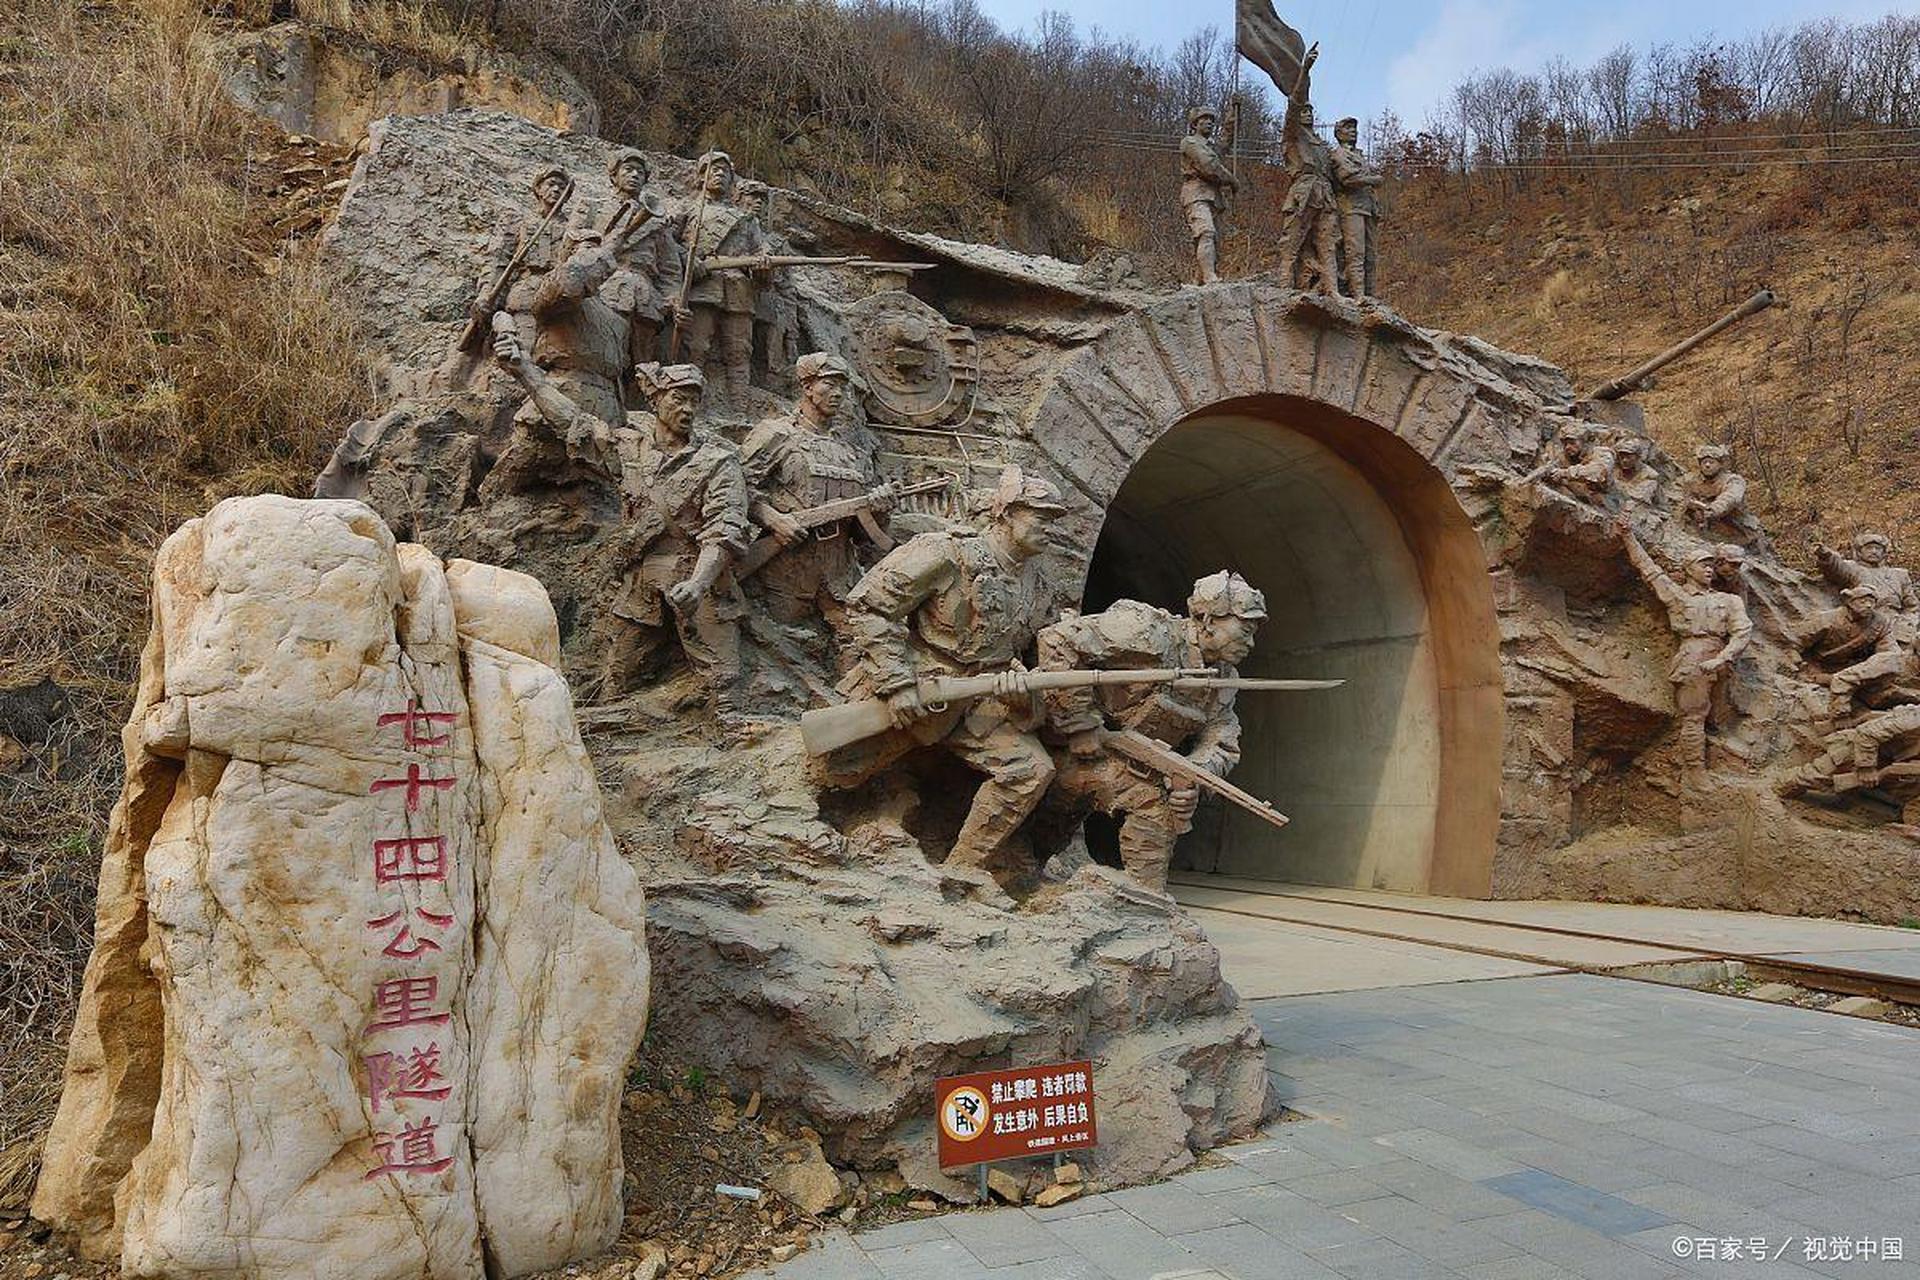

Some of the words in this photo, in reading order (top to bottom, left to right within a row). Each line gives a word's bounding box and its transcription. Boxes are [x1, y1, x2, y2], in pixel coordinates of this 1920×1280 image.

[365, 699, 460, 1181] 七十四公里隧道
[992, 1078, 1037, 1104] 禁止攀爬
[1042, 1072, 1087, 1097] 违者罚款
[993, 1108, 1039, 1135] 发生意外
[1044, 1102, 1088, 1127] 后果自负
